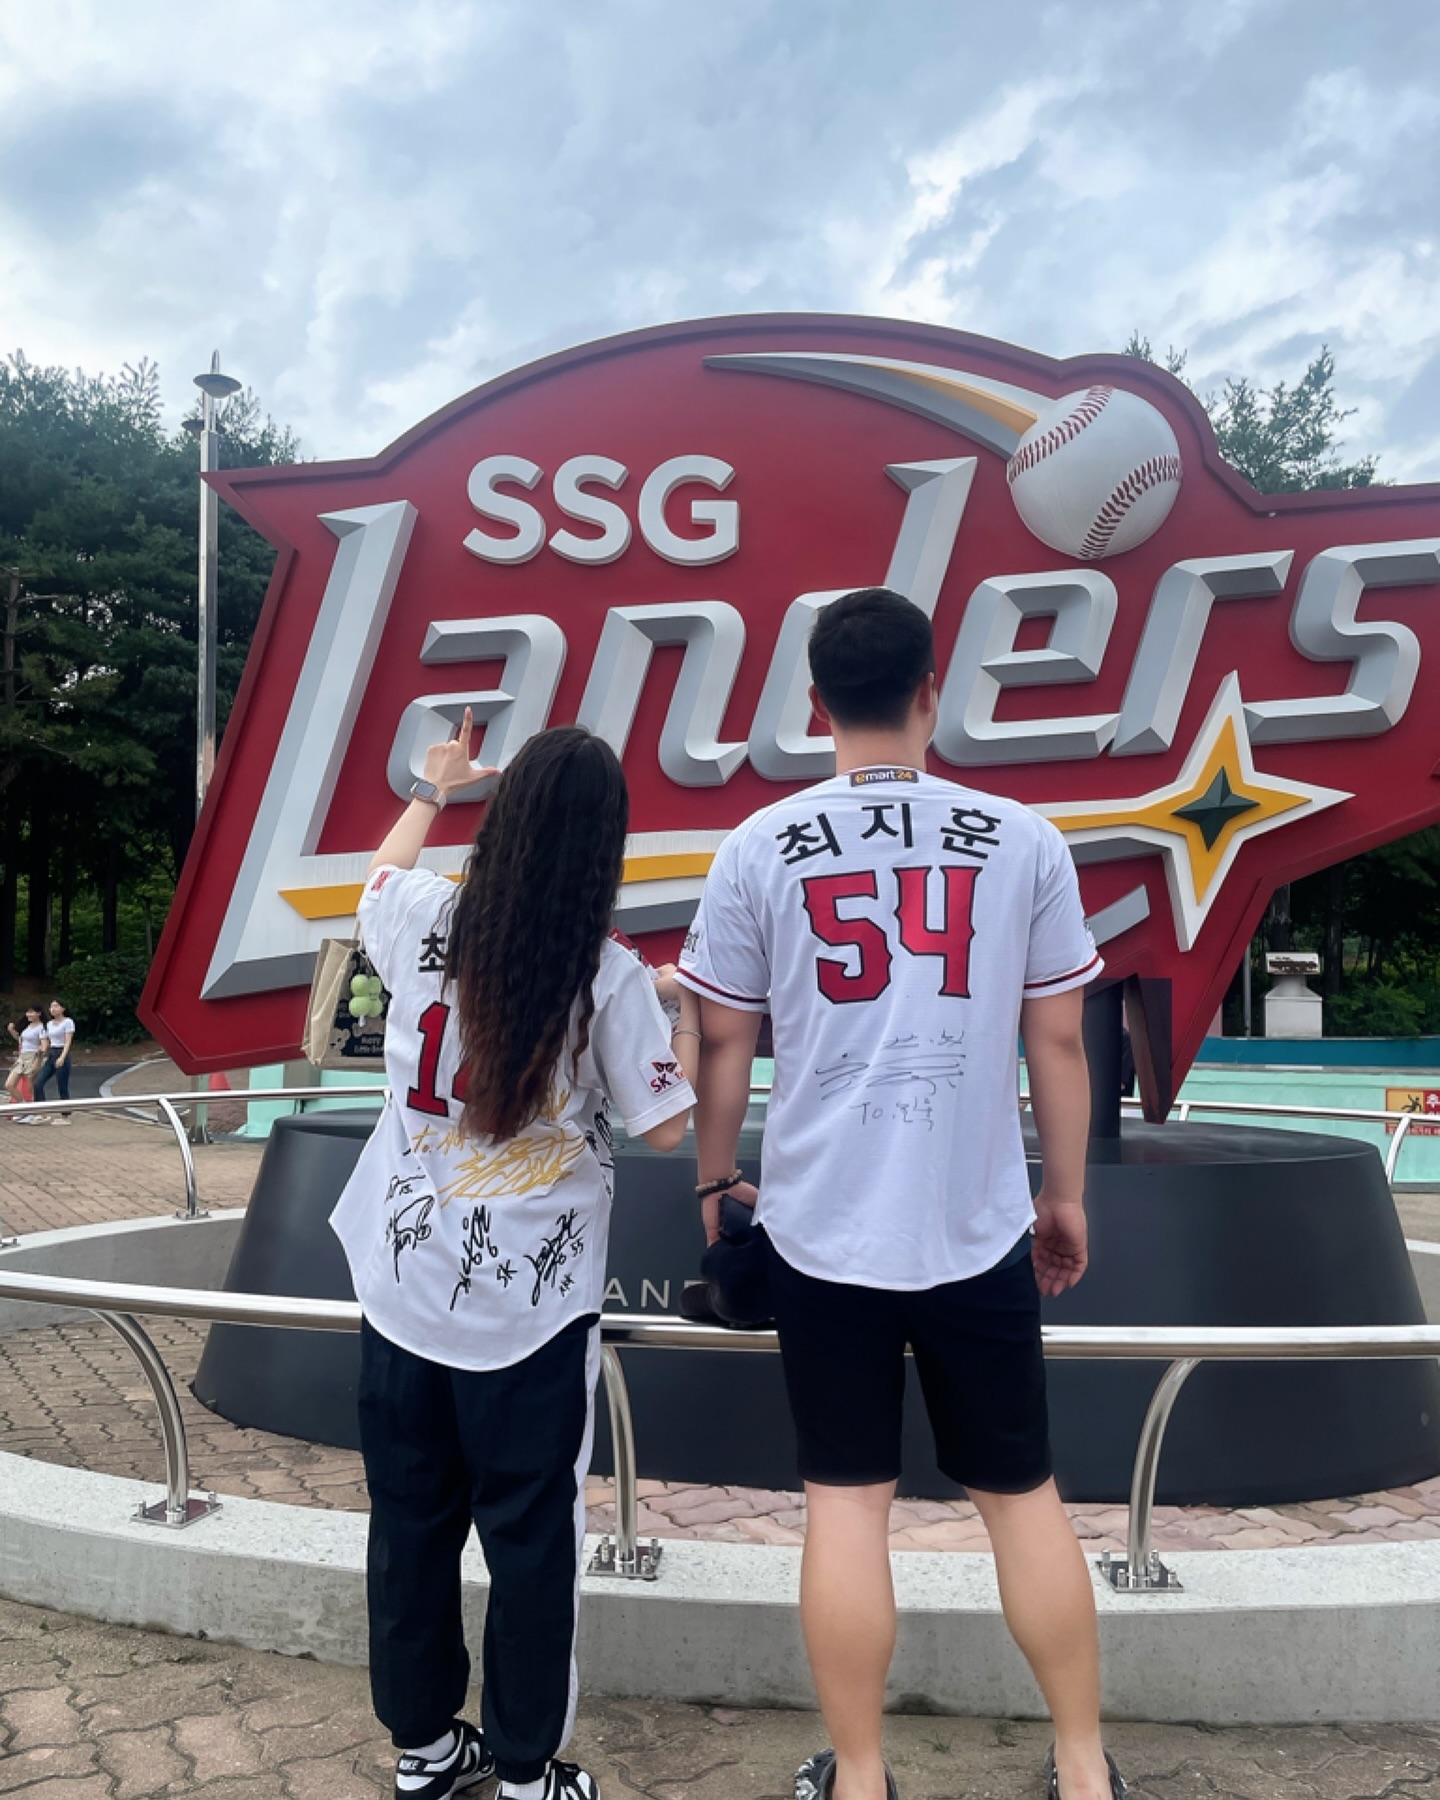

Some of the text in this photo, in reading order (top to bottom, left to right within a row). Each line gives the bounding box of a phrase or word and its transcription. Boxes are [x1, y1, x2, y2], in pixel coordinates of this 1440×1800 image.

[463, 455, 739, 565] SSG
[200, 456, 1440, 999] Landers
[775, 803, 1002, 866] 최지훈
[802, 865, 983, 1004] 54
[600, 1277, 710, 1310] AN
